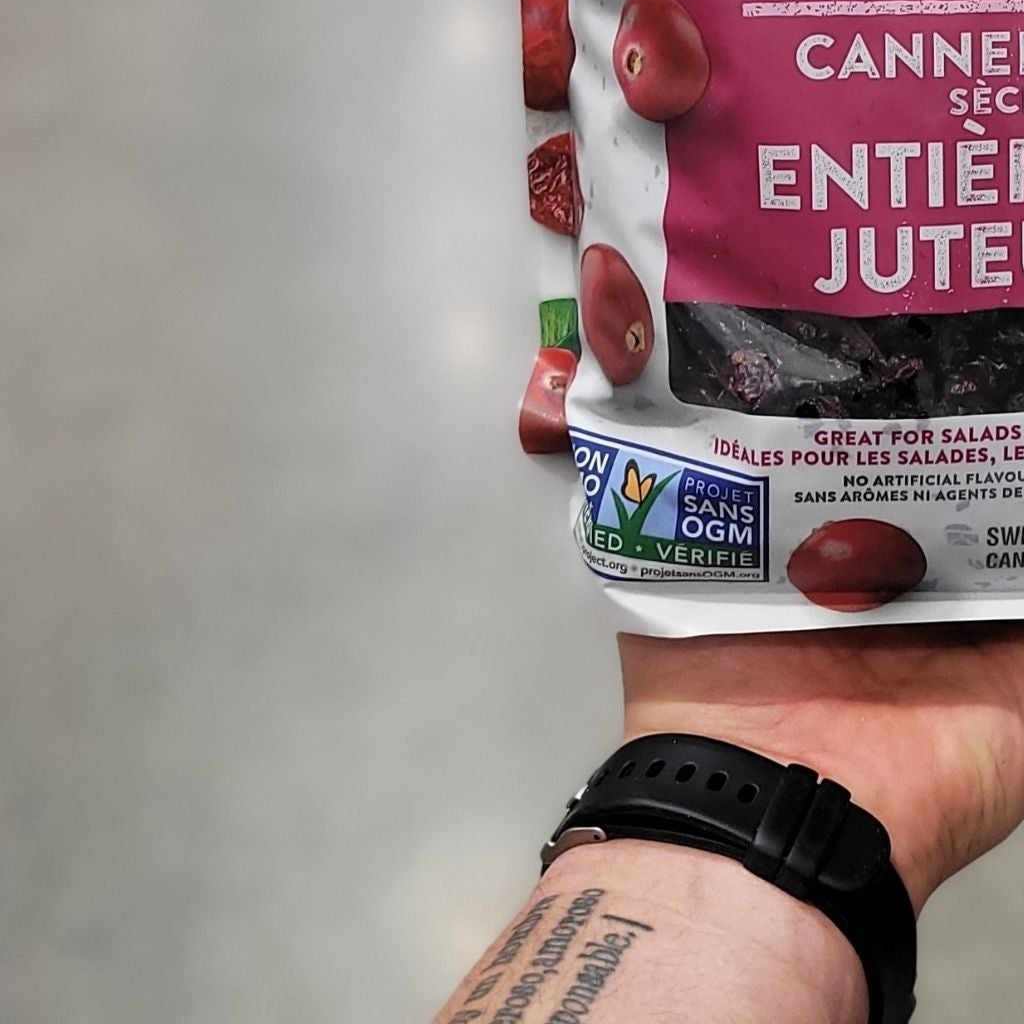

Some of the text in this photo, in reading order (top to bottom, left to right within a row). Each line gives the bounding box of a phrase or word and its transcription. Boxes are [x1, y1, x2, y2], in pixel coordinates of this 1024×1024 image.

[814, 430, 881, 446] GREAT
[891, 429, 934, 445] FOR
[573, 443, 609, 474] ON
[714, 437, 783, 467] IDÉALES
[792, 450, 849, 466] POUR
[857, 450, 891, 466] LES
[897, 446, 996, 466] SALADES,
[685, 476, 754, 503] PROJET
[843, 475, 869, 487] NO
[873, 473, 961, 487] ARTIFICIAL
[794, 490, 837, 503] SANS
[840, 488, 908, 502] ARÔMES
[913, 490, 930, 502] NI
[935, 488, 997, 502] AGENTS
[1002, 487, 1023, 499] DE
[683, 495, 754, 524] SANS
[681, 516, 753, 545] OGM
